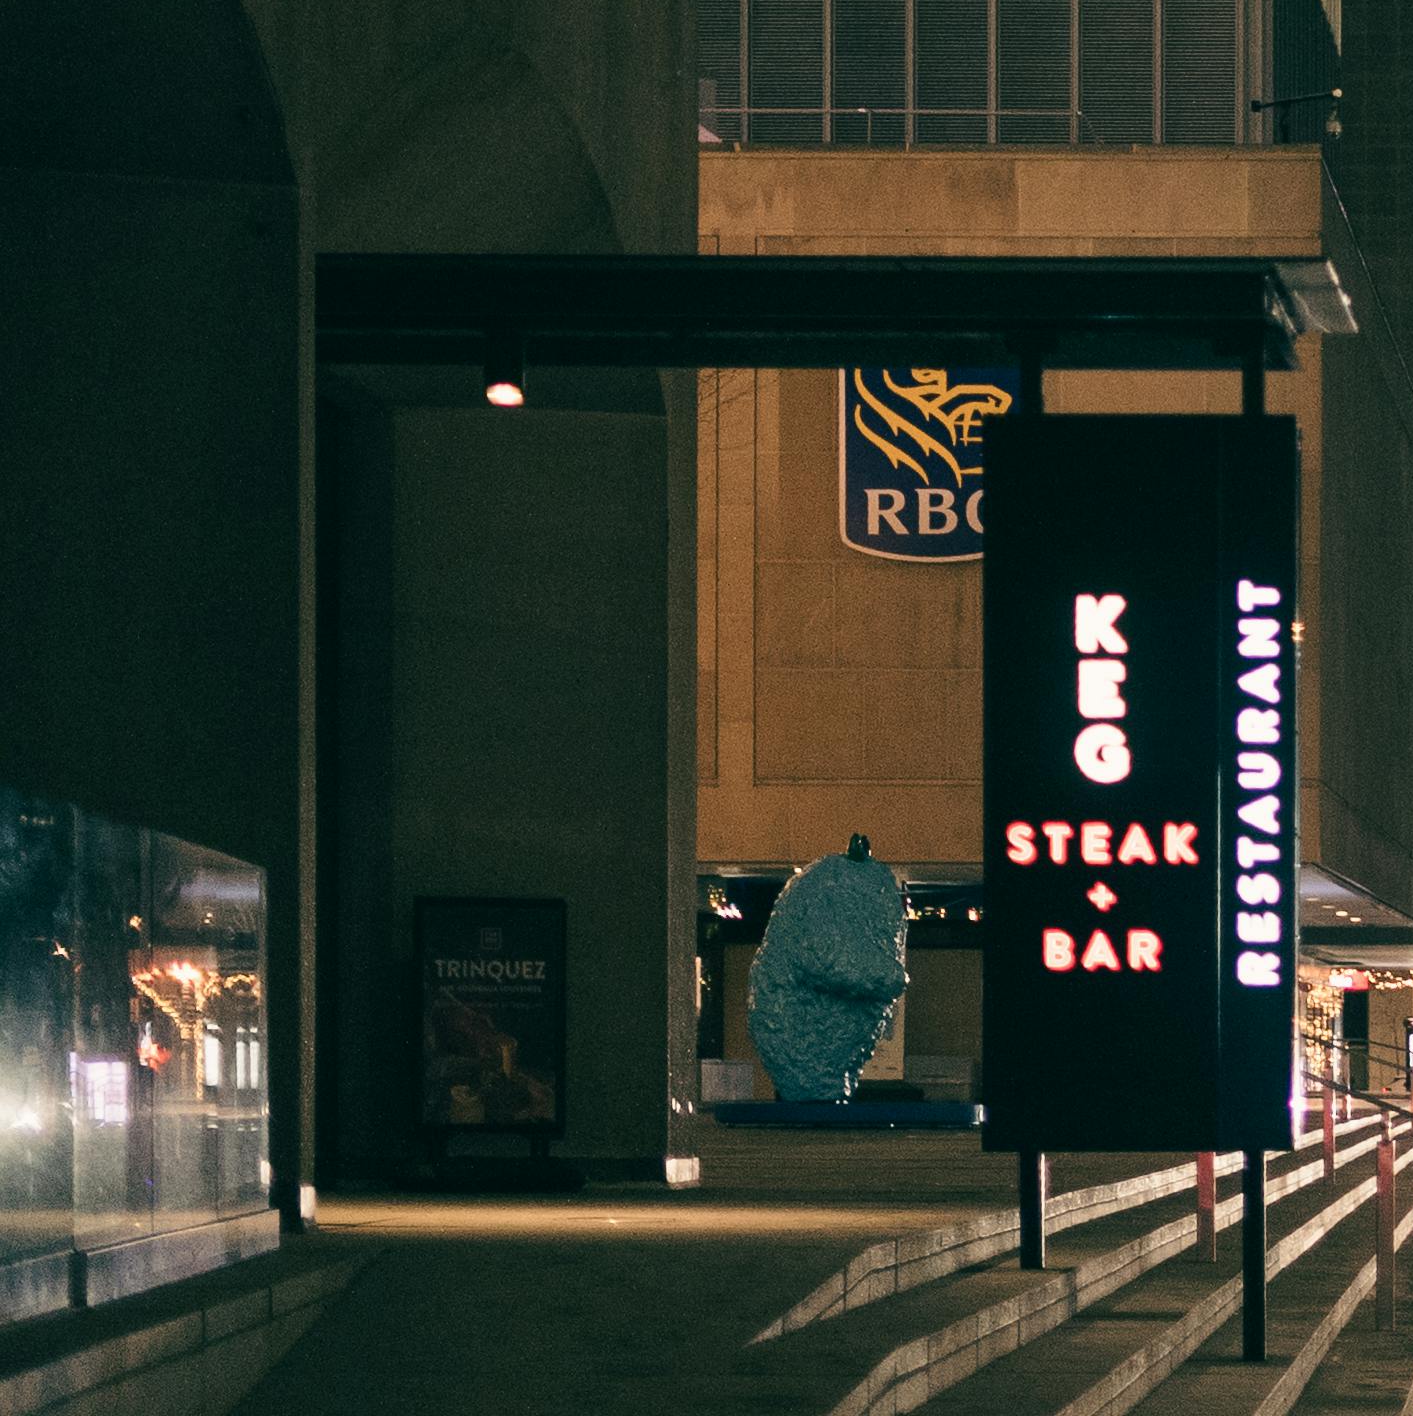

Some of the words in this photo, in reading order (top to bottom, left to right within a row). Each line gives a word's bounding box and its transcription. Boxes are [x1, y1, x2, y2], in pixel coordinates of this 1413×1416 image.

[1073, 593, 1132, 785] KEG
[1236, 578, 1281, 987] RESTAURANT
[1005, 821, 1200, 865] STEAK
[434, 959, 546, 983] TRINQUEZ
[1042, 929, 1164, 972] BAR
